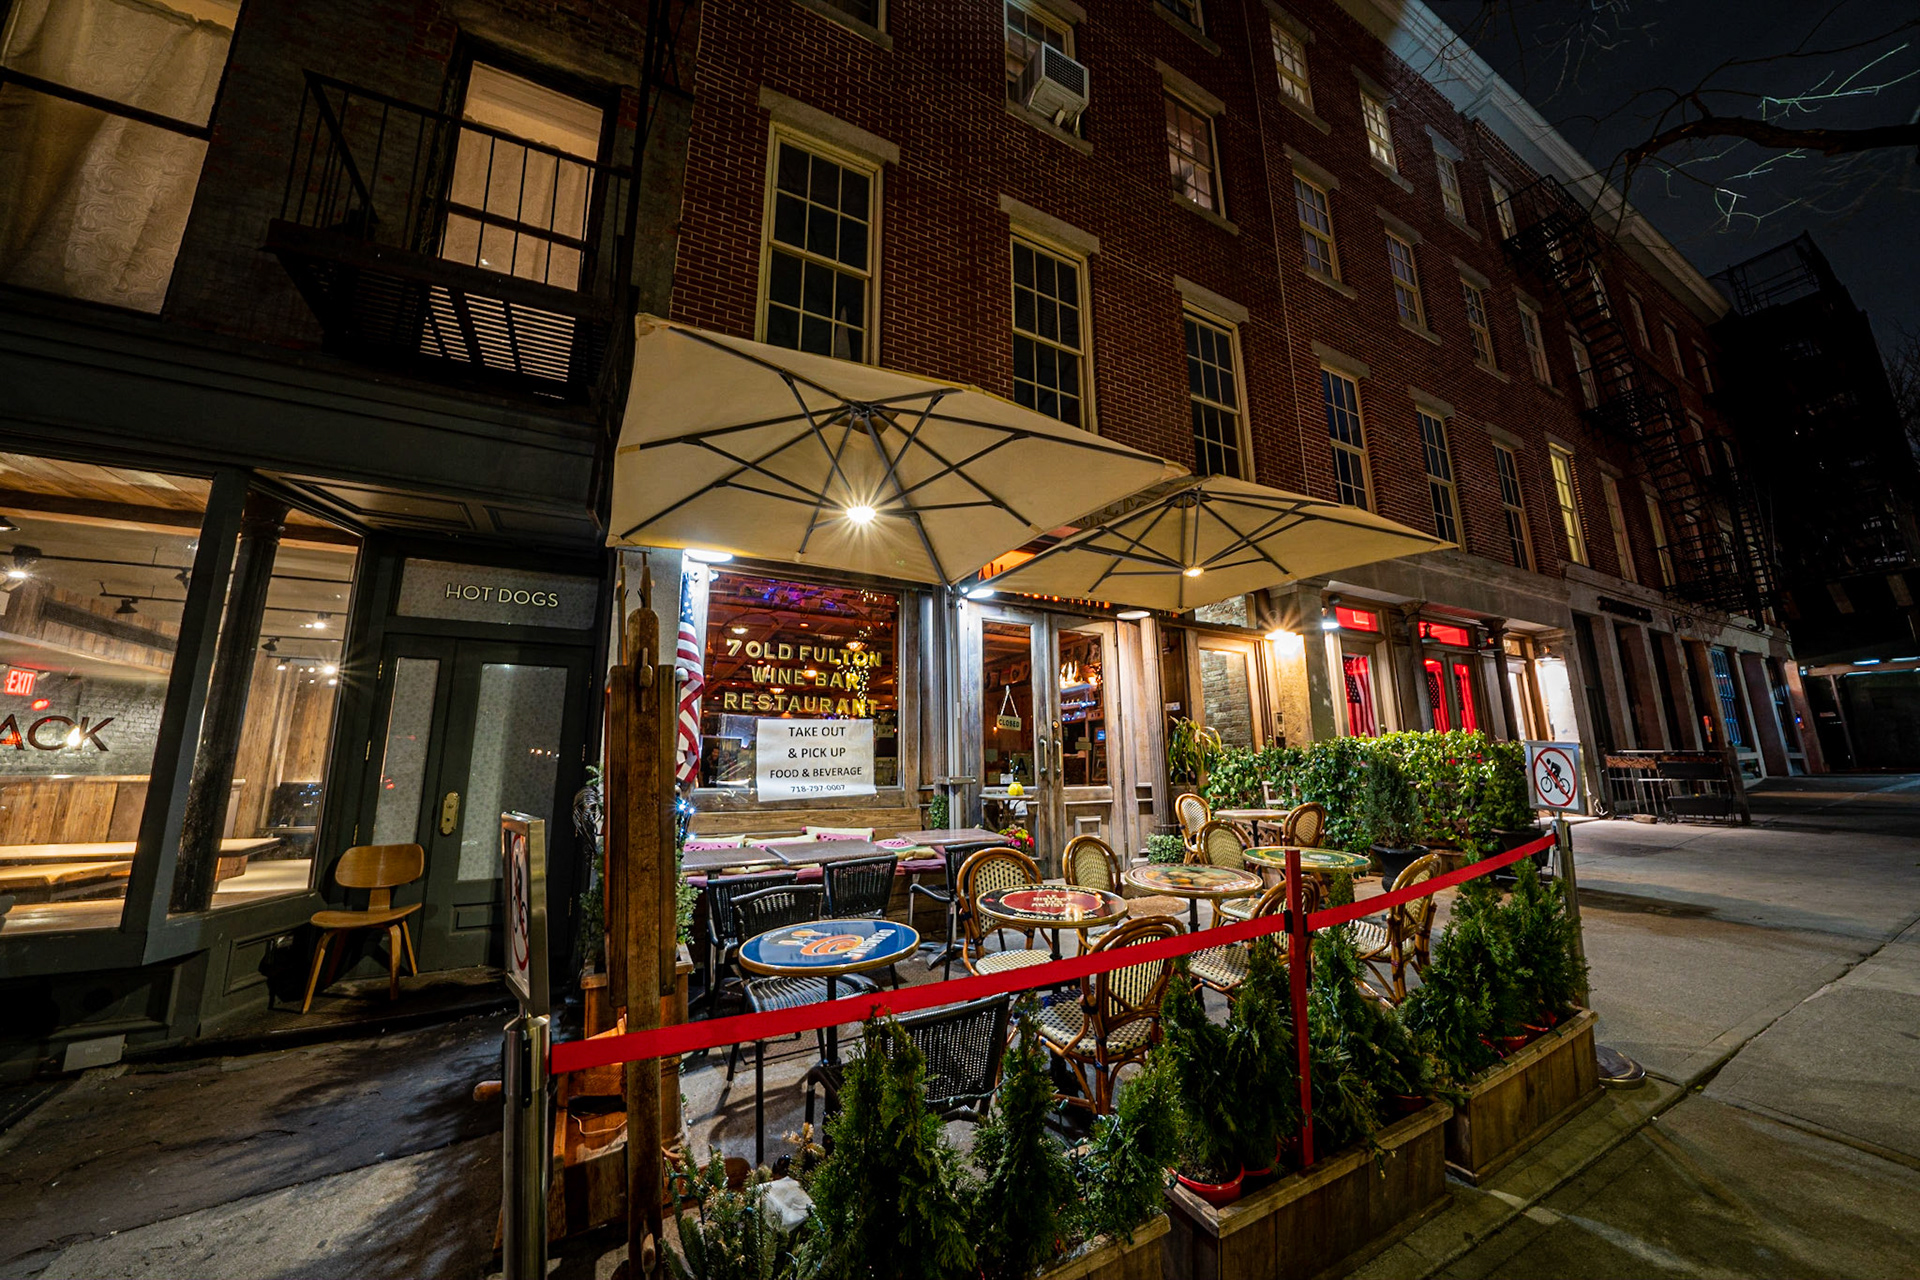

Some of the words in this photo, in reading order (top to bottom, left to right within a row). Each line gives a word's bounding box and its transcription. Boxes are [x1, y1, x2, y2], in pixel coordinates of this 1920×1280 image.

[445, 583, 494, 602] HOT
[497, 588, 560, 608] DOGS
[725, 639, 743, 657] 7
[744, 640, 794, 661] OLD
[799, 645, 883, 668] FULTON
[7, 670, 35, 694] EXIT
[750, 665, 806, 686] WINE
[814, 671, 861, 691] BAR
[723, 691, 880, 716] RESTAURANT
[788, 726, 818, 737] TAKE
[821, 726, 847, 737] OUT
[998, 718, 1020, 728] CLOSED
[787, 748, 798, 759] &
[801, 748, 828, 758] PICK
[830, 747, 847, 757] UP
[770, 769, 799, 779] FOOD
[801, 768, 810, 778] &
[812, 766, 863, 777] BEVERAGE
[1015, 758, 1028, 776] A
